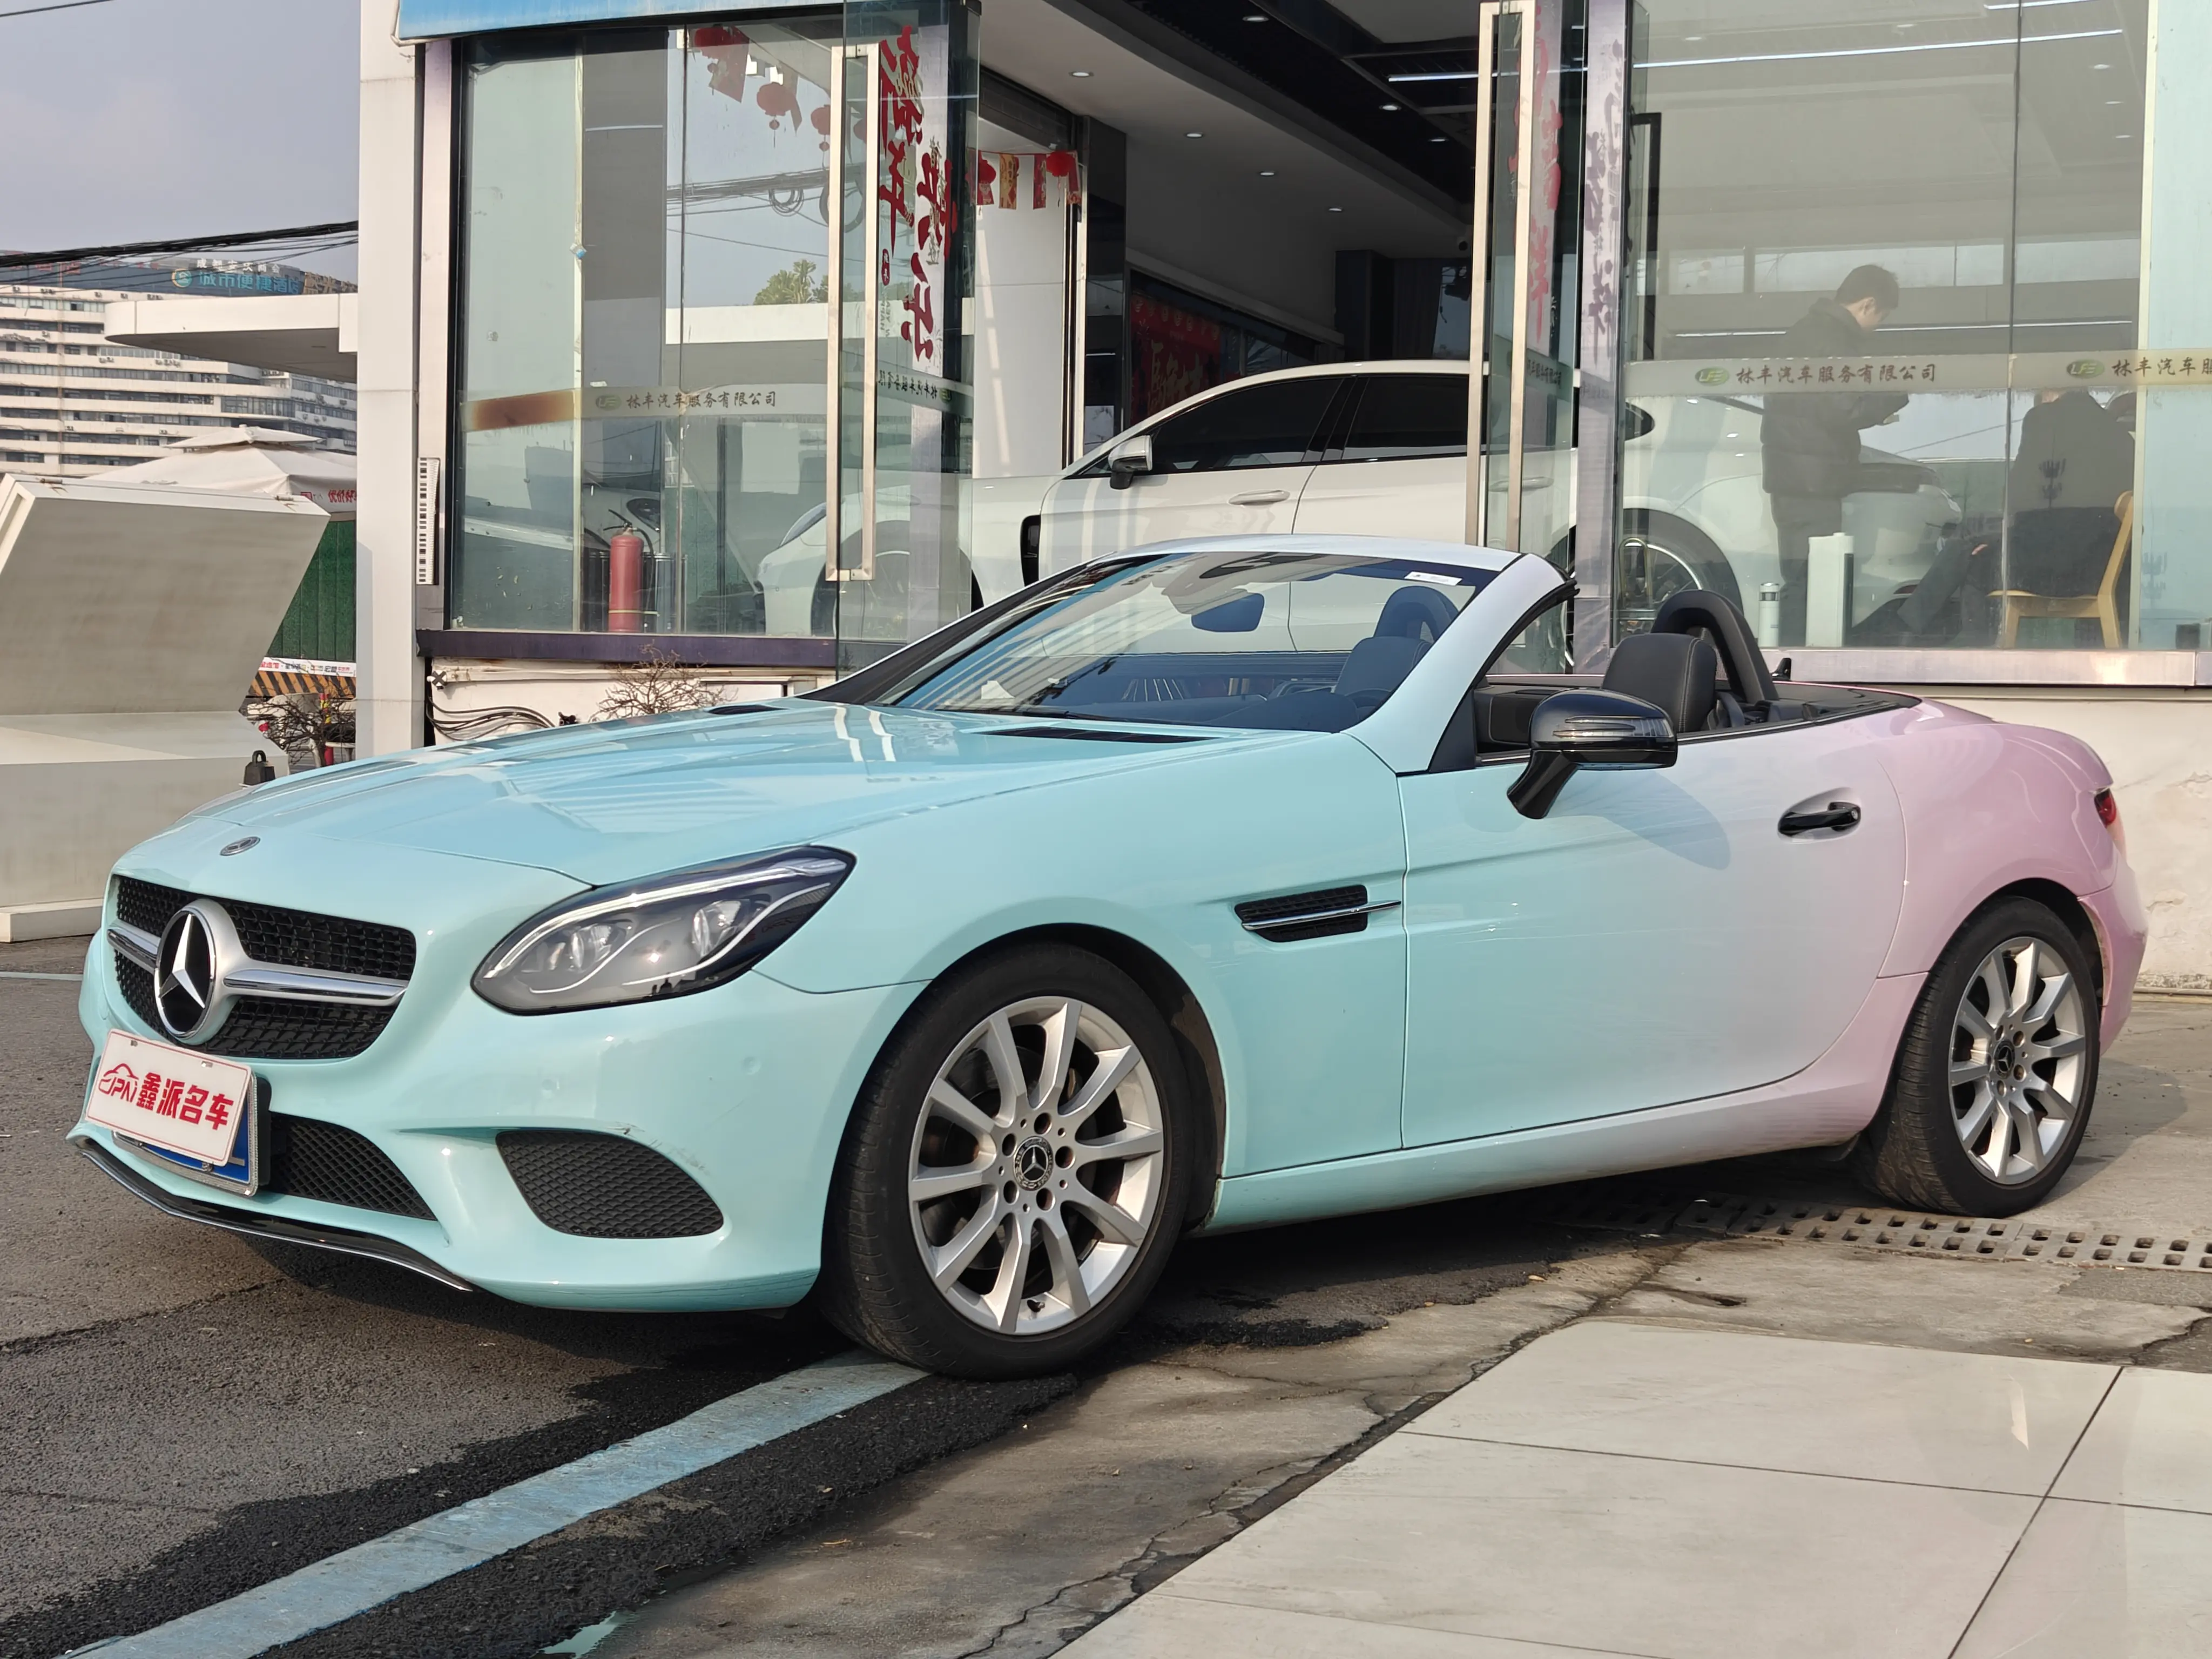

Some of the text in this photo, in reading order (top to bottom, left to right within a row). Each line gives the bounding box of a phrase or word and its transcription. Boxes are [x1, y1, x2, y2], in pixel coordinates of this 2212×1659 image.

[199, 271, 299, 295] 城市便捷酒店
[1736, 363, 1937, 386] 林丰汽车服务有限公司
[626, 391, 776, 410] 林丰汽车服务有限公司
[136, 1071, 234, 1131] 鑫派名车
